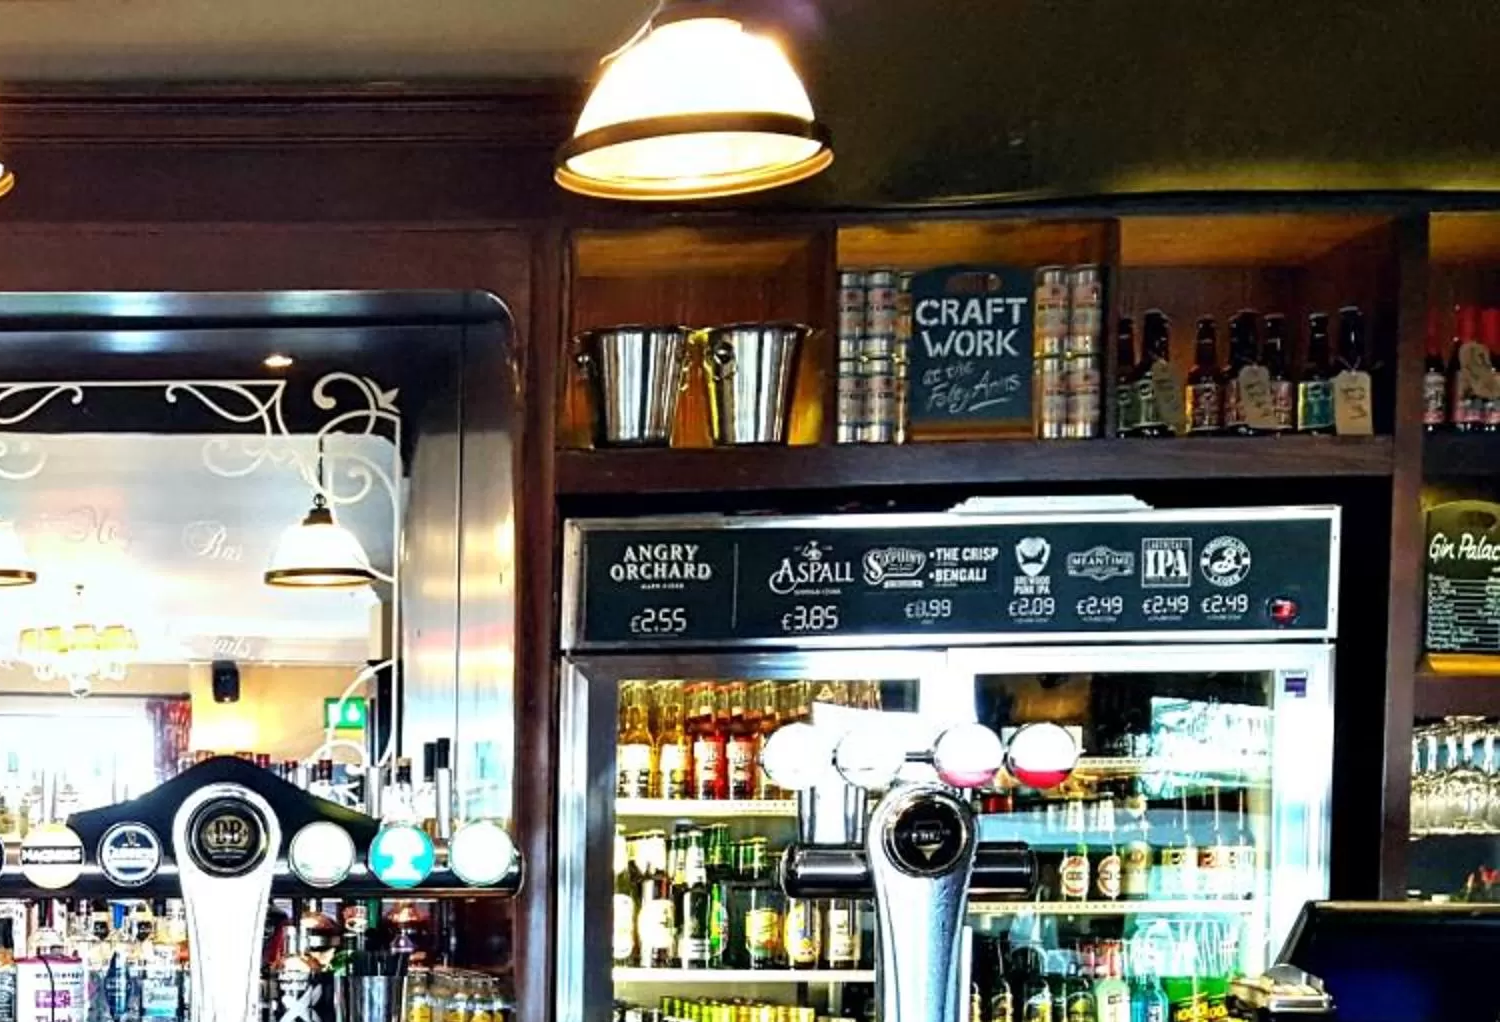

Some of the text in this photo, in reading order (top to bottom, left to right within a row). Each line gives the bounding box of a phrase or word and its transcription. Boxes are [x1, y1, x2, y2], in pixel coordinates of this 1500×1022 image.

[915, 296, 1028, 326] CRAFT
[921, 328, 1019, 357] WORK
[622, 543, 700, 563] ANGRY
[935, 547, 999, 562] THE CRISP
[1429, 532, 1455, 562] Gin
[609, 561, 712, 582] ORCHARD
[1146, 549, 1188, 577] IPA
[935, 567, 987, 583] BENGALI
[1008, 597, 1055, 617] £2.09
[1076, 595, 1123, 615] £2.49
[1142, 595, 1189, 615] £2.49
[1202, 593, 1249, 613] £2.49
[630, 607, 687, 633] £2.55
[781, 604, 839, 631] £3.85
